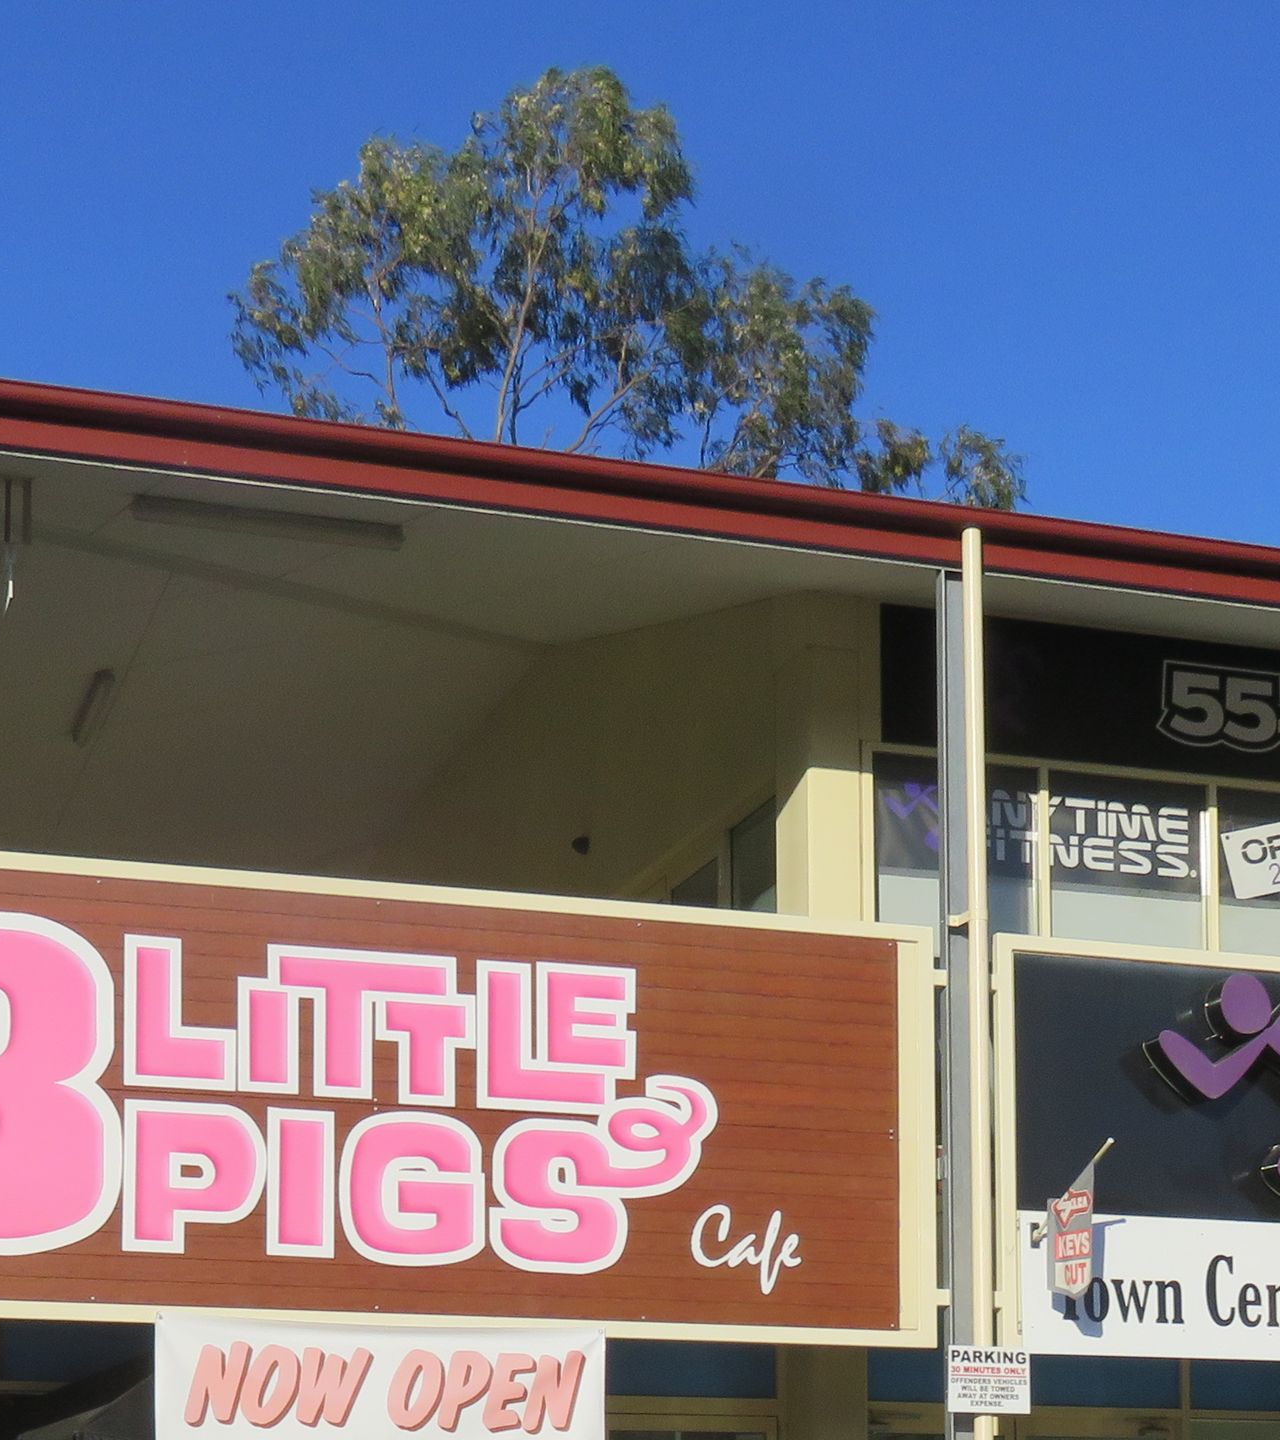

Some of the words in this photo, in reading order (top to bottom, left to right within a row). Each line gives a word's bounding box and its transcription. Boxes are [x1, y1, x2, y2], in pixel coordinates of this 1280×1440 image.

[987, 789, 1189, 844] NYTIME
[123, 935, 637, 1115] LITTLE
[122, 1098, 635, 1272] PIGS
[690, 1204, 802, 1296] Cafe
[1058, 1231, 1090, 1258] KEYS
[1064, 1262, 1087, 1286] CUT
[951, 1350, 1027, 1364] PARKING
[963, 1366, 1000, 1374] MINUTES
[1004, 1367, 1026, 1375] ONLY
[183, 1341, 370, 1430] NOW
[386, 1347, 586, 1434] OPEN
